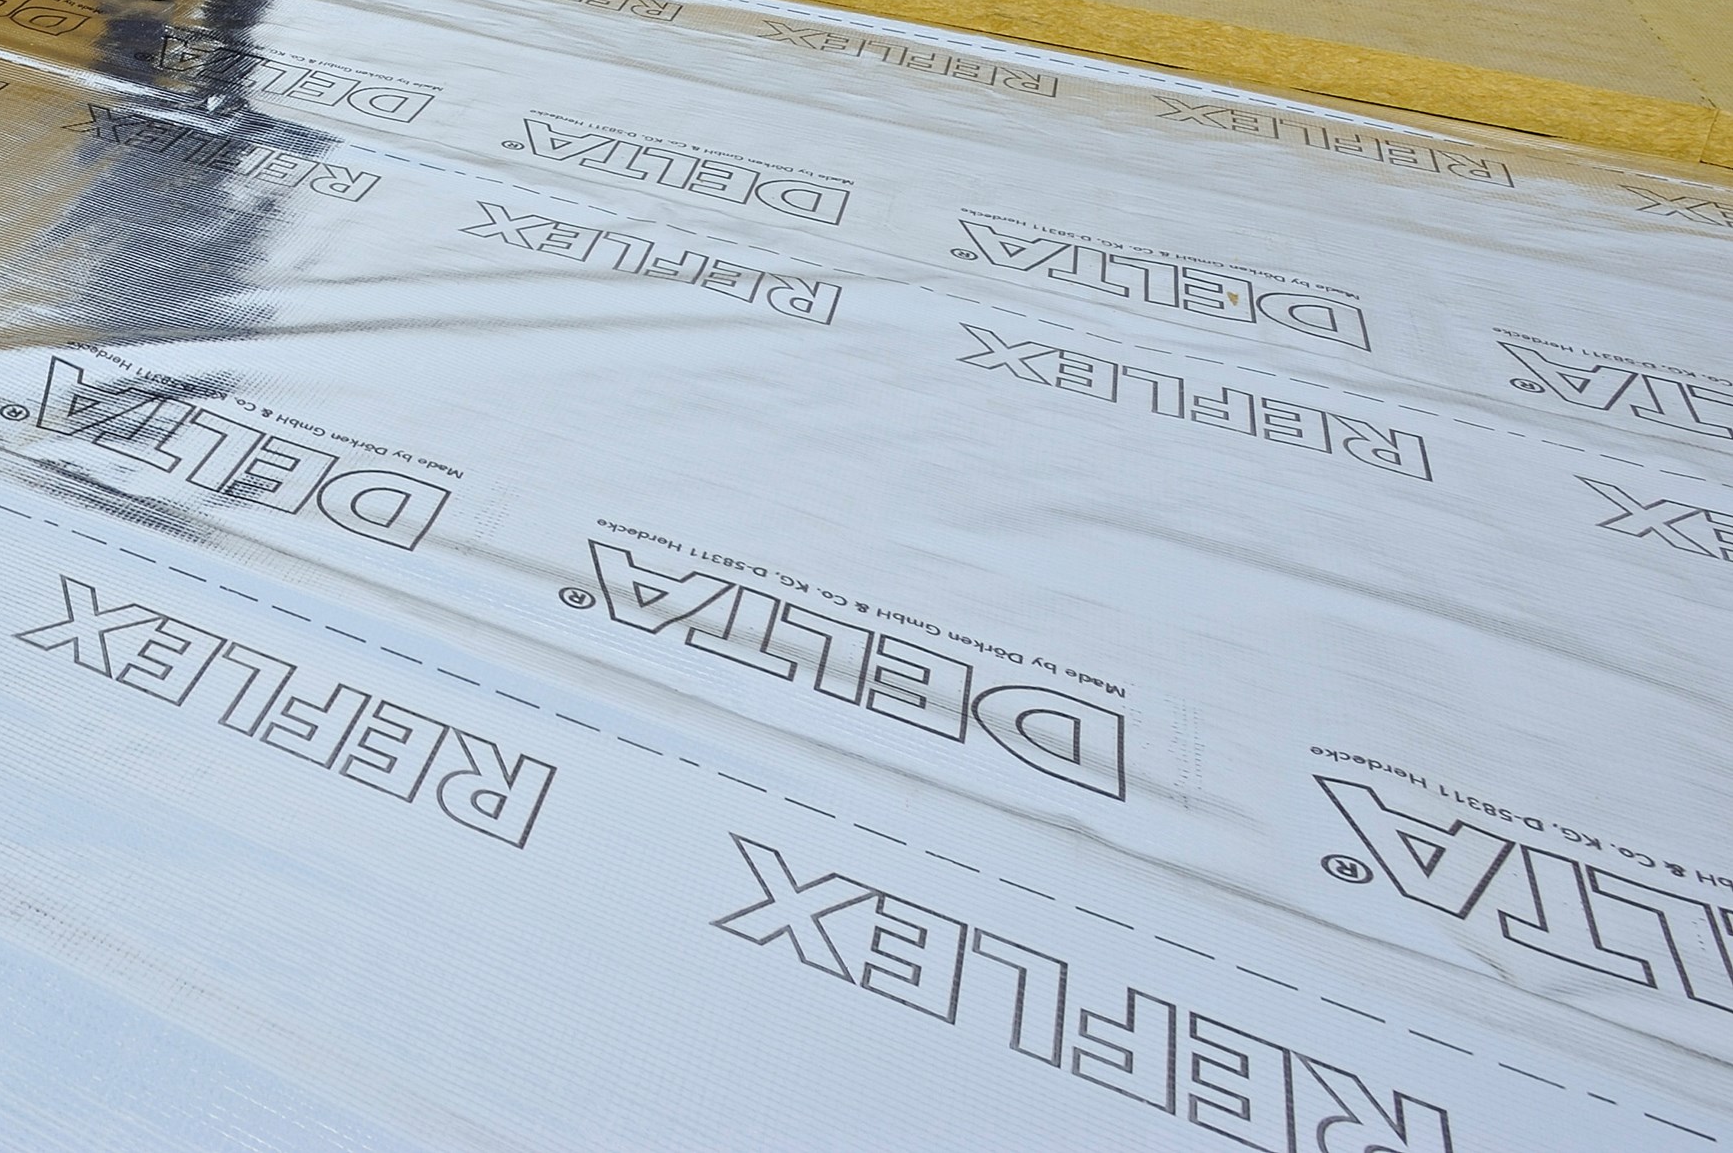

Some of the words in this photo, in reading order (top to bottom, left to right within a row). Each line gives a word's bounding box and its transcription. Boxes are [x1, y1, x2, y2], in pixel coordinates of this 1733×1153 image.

[757, 20, 1059, 97] REFLEX
[529, 109, 584, 126] Herdecke
[1152, 95, 1515, 188] REFLEX
[703, 148, 744, 161] GmbH
[747, 157, 795, 173] Dörken
[797, 167, 814, 177] by
[817, 173, 855, 186] Made
[960, 207, 1027, 226] Herdecke
[1127, 244, 1154, 255] Co.
[1158, 249, 1169, 257] &
[459, 200, 843, 326] REFLEX
[1175, 254, 1225, 268] GmbH
[1229, 263, 1286, 283] Dörken
[1289, 277, 1311, 289] by
[1315, 284, 1360, 300] Made
[1492, 327, 1574, 353] Herdecke
[1582, 349, 1656, 369] D-58311
[233, 397, 257, 412] Co.
[955, 322, 1434, 482] REFLEX
[261, 408, 274, 419] &
[275, 414, 327, 438] GmbH
[329, 431, 388, 457] Dörken
[390, 448, 413, 463] by
[415, 457, 465, 480] Made
[596, 518, 682, 553] Herdecke
[689, 547, 768, 578] D-58311
[773, 571, 809, 593] KG,
[815, 586, 848, 607] Co.
[854, 600, 870, 614] &
[876, 607, 941, 637] GmbH
[948, 630, 1024, 665] Dörken
[1031, 657, 1057, 675] by
[1065, 667, 1126, 698] Made
[12, 574, 557, 848] REFLEX
[1309, 745, 1428, 789] Herdecke
[1437, 783, 1545, 833] D-58311
[1607, 842, 1657, 870] Co.
[1663, 859, 1686, 878] &
